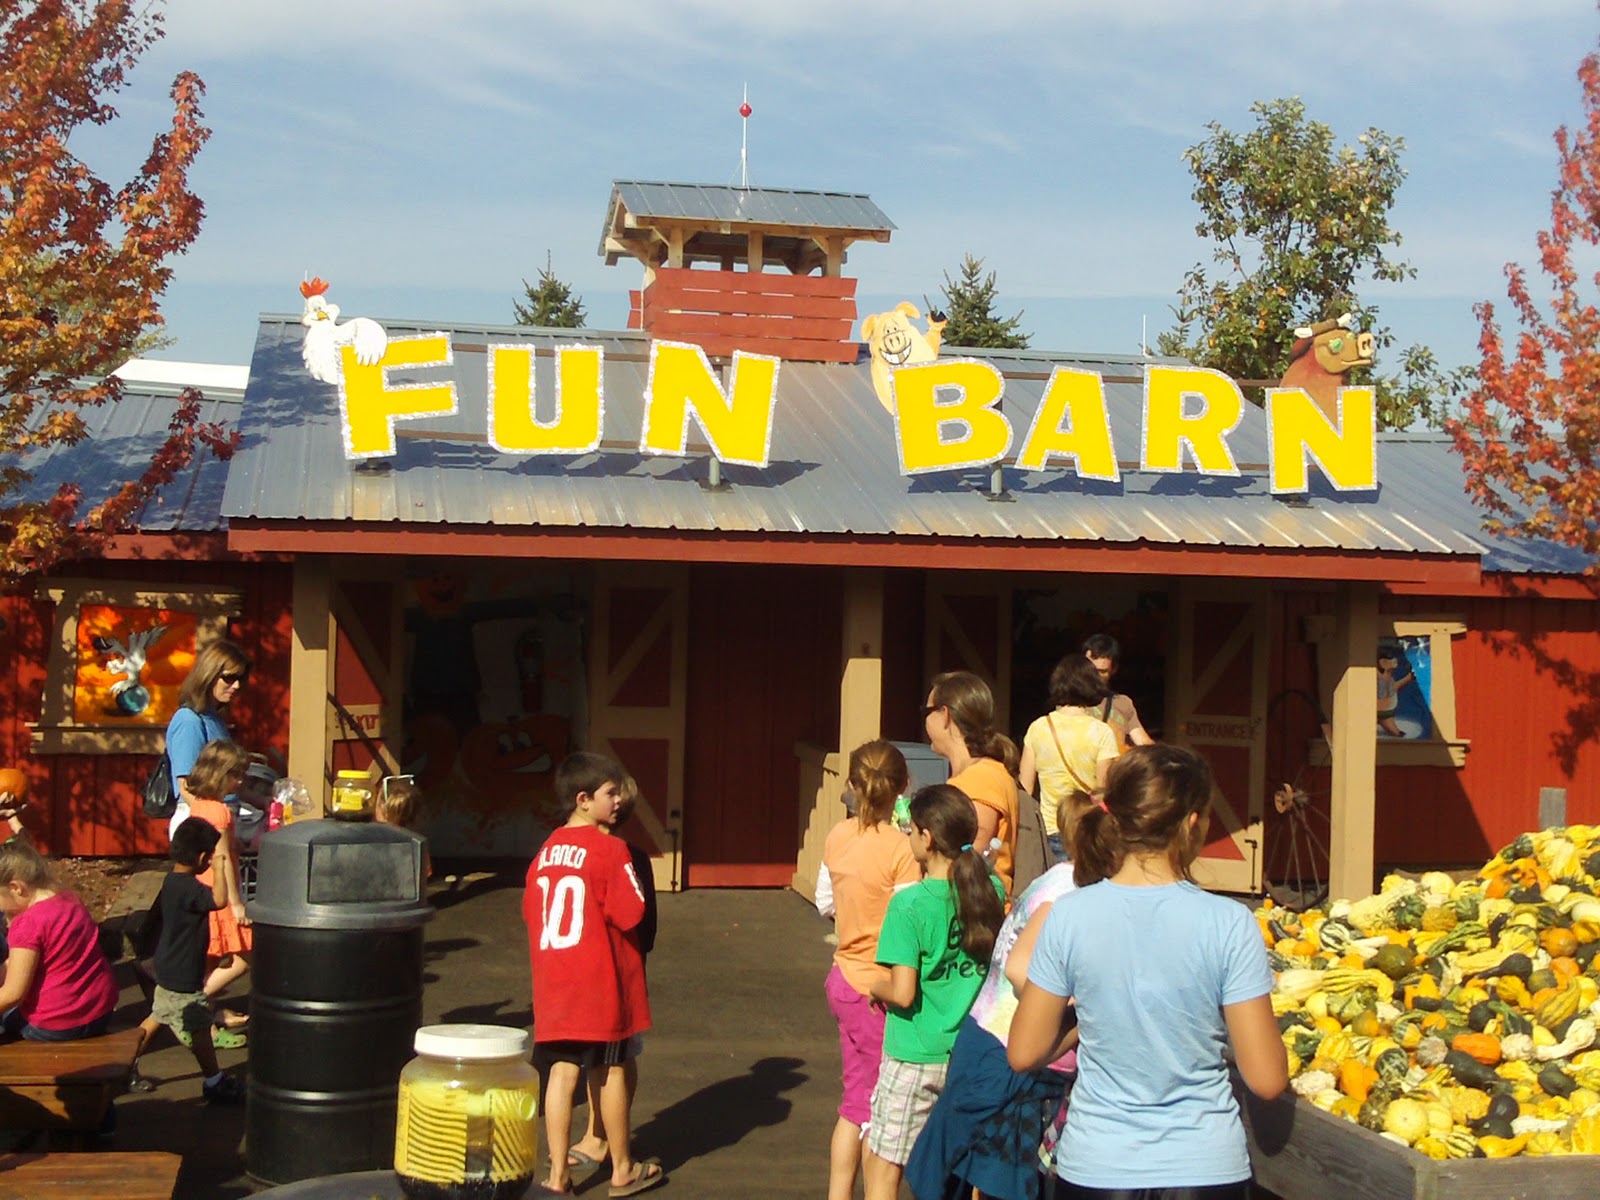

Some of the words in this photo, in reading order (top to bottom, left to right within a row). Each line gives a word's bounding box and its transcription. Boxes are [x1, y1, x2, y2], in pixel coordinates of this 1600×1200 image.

[336, 331, 782, 469] FUN
[887, 356, 1378, 495] BARN
[1185, 720, 1249, 740] ENTRANCE
[537, 875, 586, 950] 10
